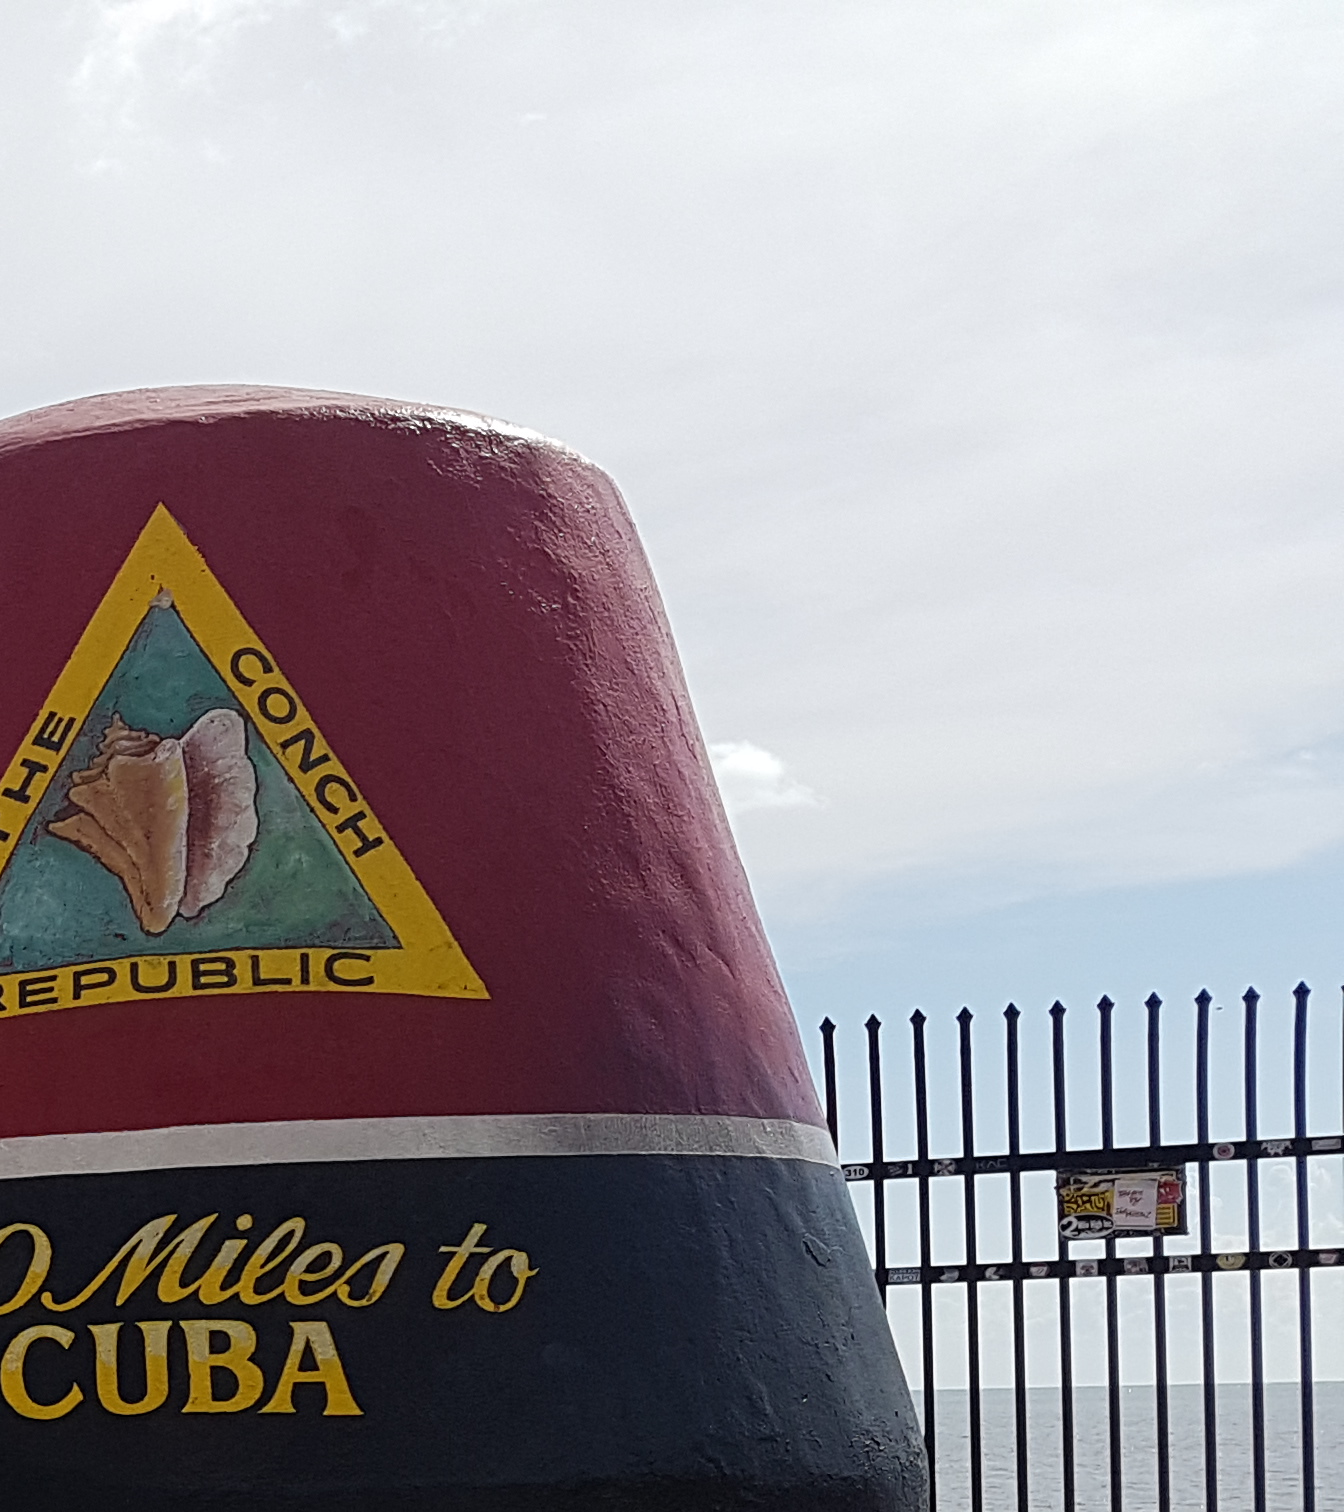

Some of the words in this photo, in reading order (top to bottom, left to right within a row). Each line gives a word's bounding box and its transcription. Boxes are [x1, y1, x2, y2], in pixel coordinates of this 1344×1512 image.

[230, 646, 384, 859] CONCH
[41, 1212, 405, 1313] Miles
[431, 1222, 540, 1313] to
[0, 1318, 366, 1420] CUBA
